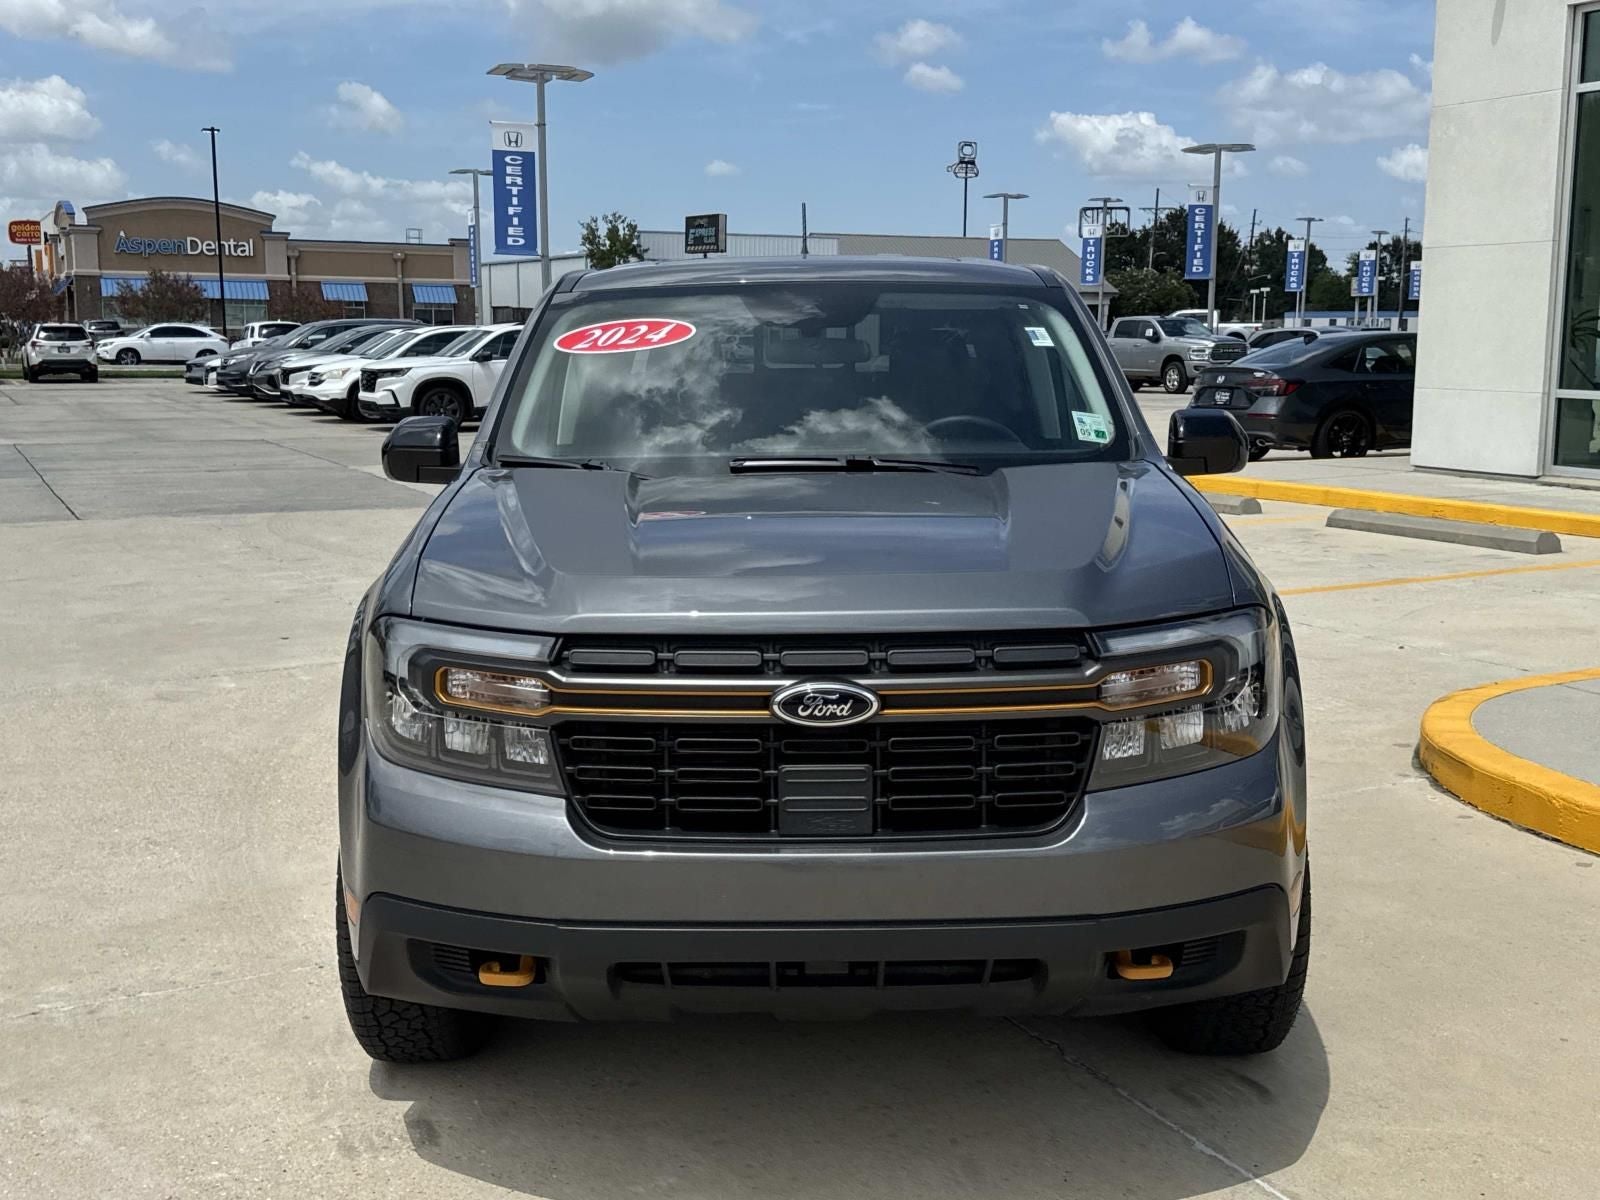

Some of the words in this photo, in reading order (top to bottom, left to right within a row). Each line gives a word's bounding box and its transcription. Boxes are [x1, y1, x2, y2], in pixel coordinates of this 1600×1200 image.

[504, 155, 525, 246] CERTIFIED
[11, 223, 40, 233] golden
[1192, 207, 1206, 273] CERTIFIED
[1085, 239, 1096, 282] TRUCKS
[1289, 252, 1300, 288] TRUCKS
[1361, 261, 1371, 293] TRUCKS
[571, 323, 677, 350] 2024
[798, 693, 853, 716] Ford
